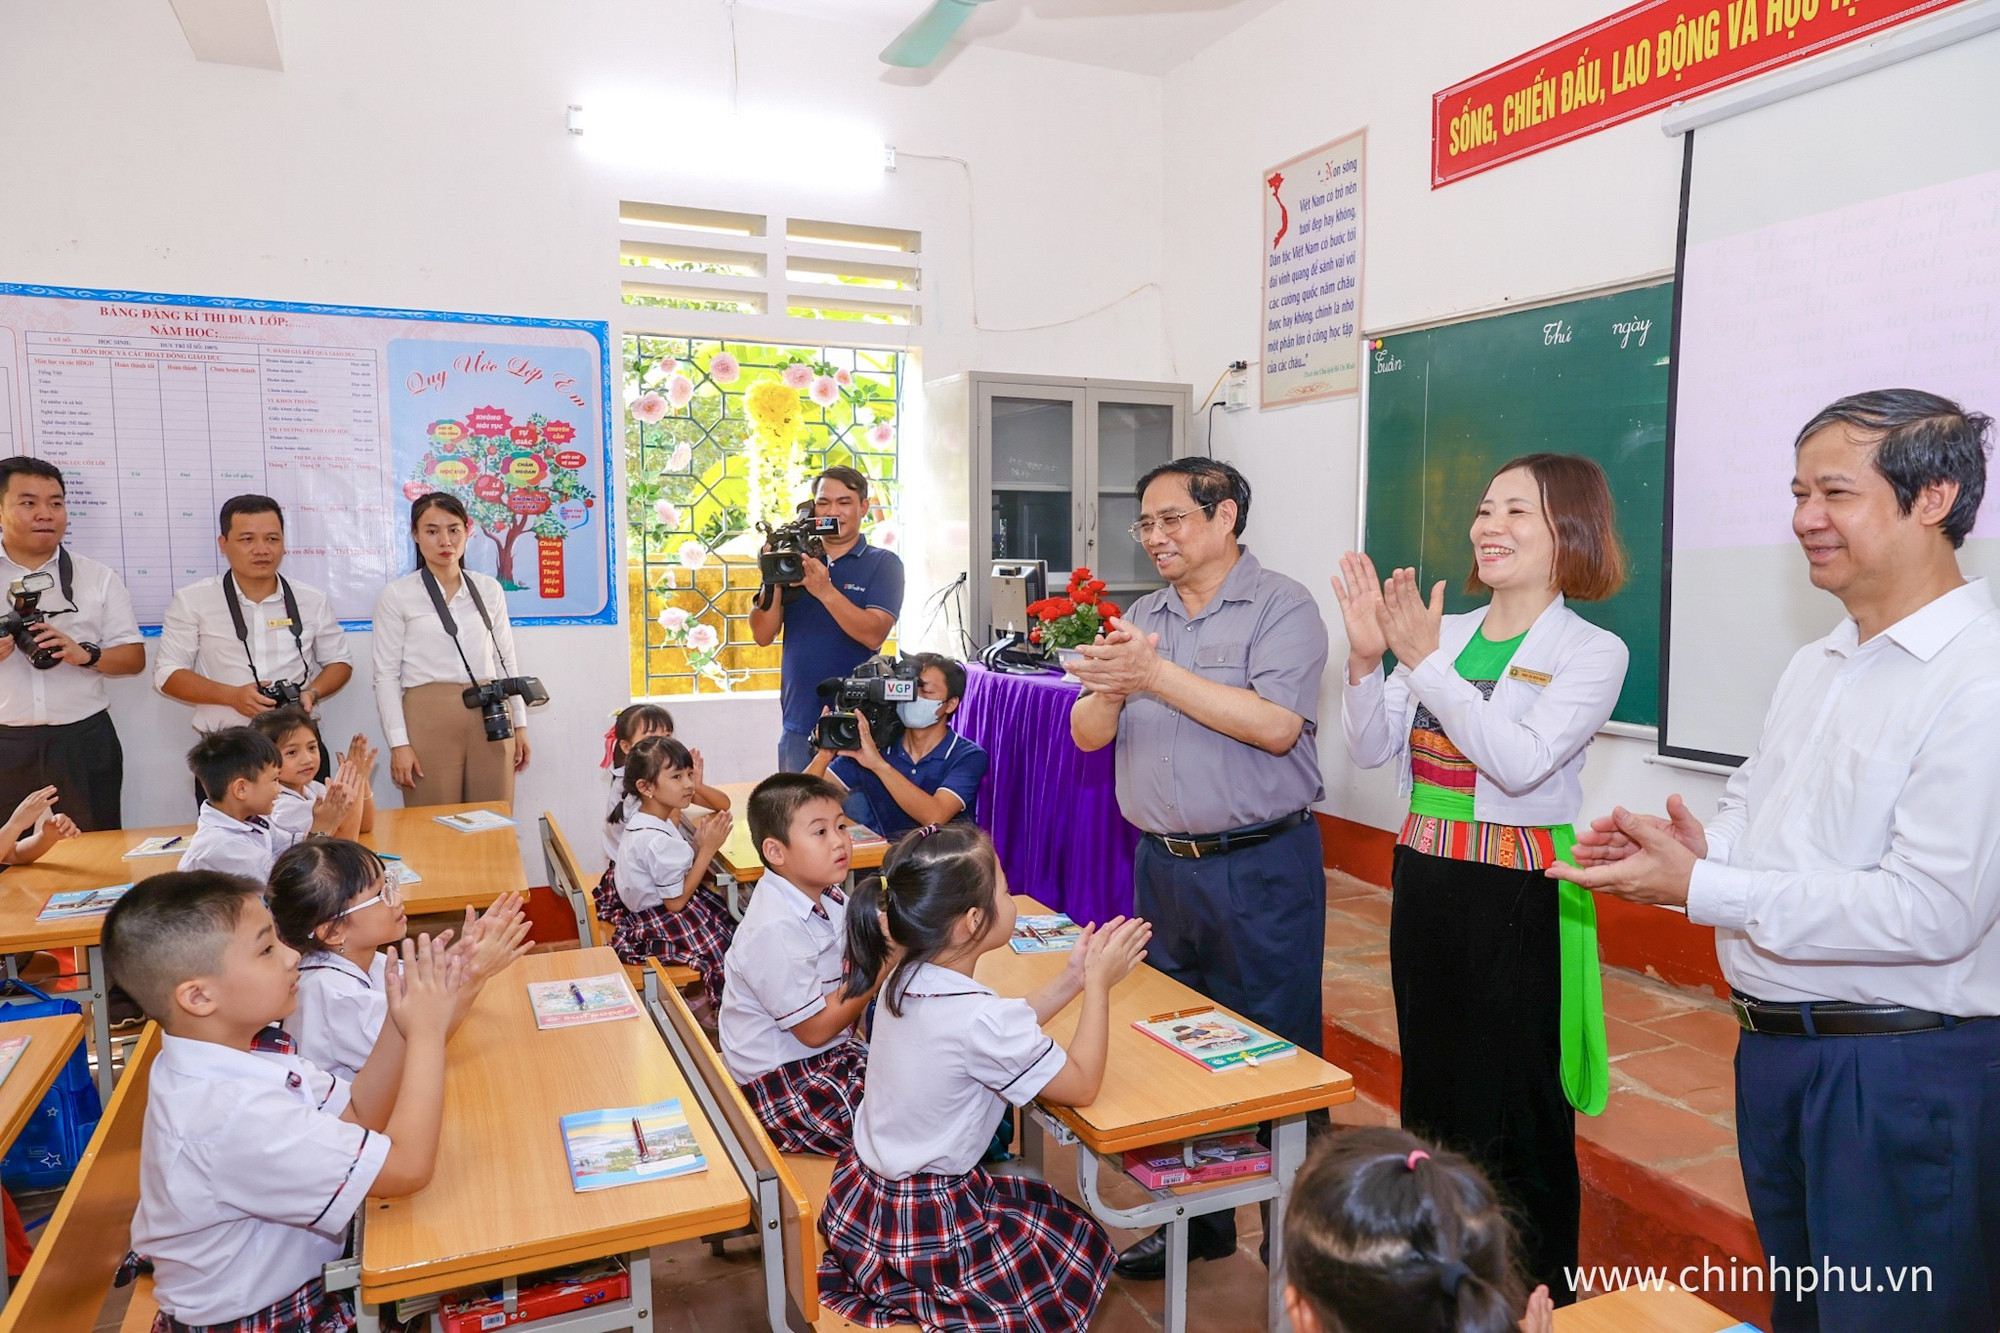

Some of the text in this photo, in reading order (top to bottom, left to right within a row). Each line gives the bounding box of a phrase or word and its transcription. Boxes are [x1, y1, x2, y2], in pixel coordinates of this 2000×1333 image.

[1449, 97, 1498, 156] SỐNG,
[1503, 68, 1557, 136] CHIẾN
[1561, 47, 1605, 114] ĐẤU,
[1612, 38, 1650, 95] LAO
[1656, 13, 1720, 81] ĐỘNG
[1300, 198, 1310, 214] Việt
[1312, 195, 1324, 208] Nam
[1324, 213, 1334, 228] hay
[1293, 245, 1303, 260] Việt
[1305, 242, 1319, 255] Nam
[1292, 268, 1309, 284] quang
[1336, 254, 1344, 268] vai
[1269, 297, 1279, 310] các
[1302, 283, 1318, 304] quốc
[1320, 282, 1335, 296] năm
[100, 304, 138, 318] BẢNG
[142, 308, 180, 320] ĐĂNG
[184, 310, 198, 321] KÍ
[202, 312, 225, 323] THI
[229, 314, 256, 325] ĐUA
[1283, 314, 1292, 328] hay
[1334, 302, 1340, 314] là
[151, 324, 182, 336] NĂM
[1329, 326, 1340, 340] học
[1342, 322, 1353, 338] tập
[1543, 315, 1652, 349] Thứ ngày
[1278, 359, 1287, 371] các
[406, 370, 447, 396] Quy
[504, 356, 543, 385] Lớp
[888, 683, 911, 693] VGP
